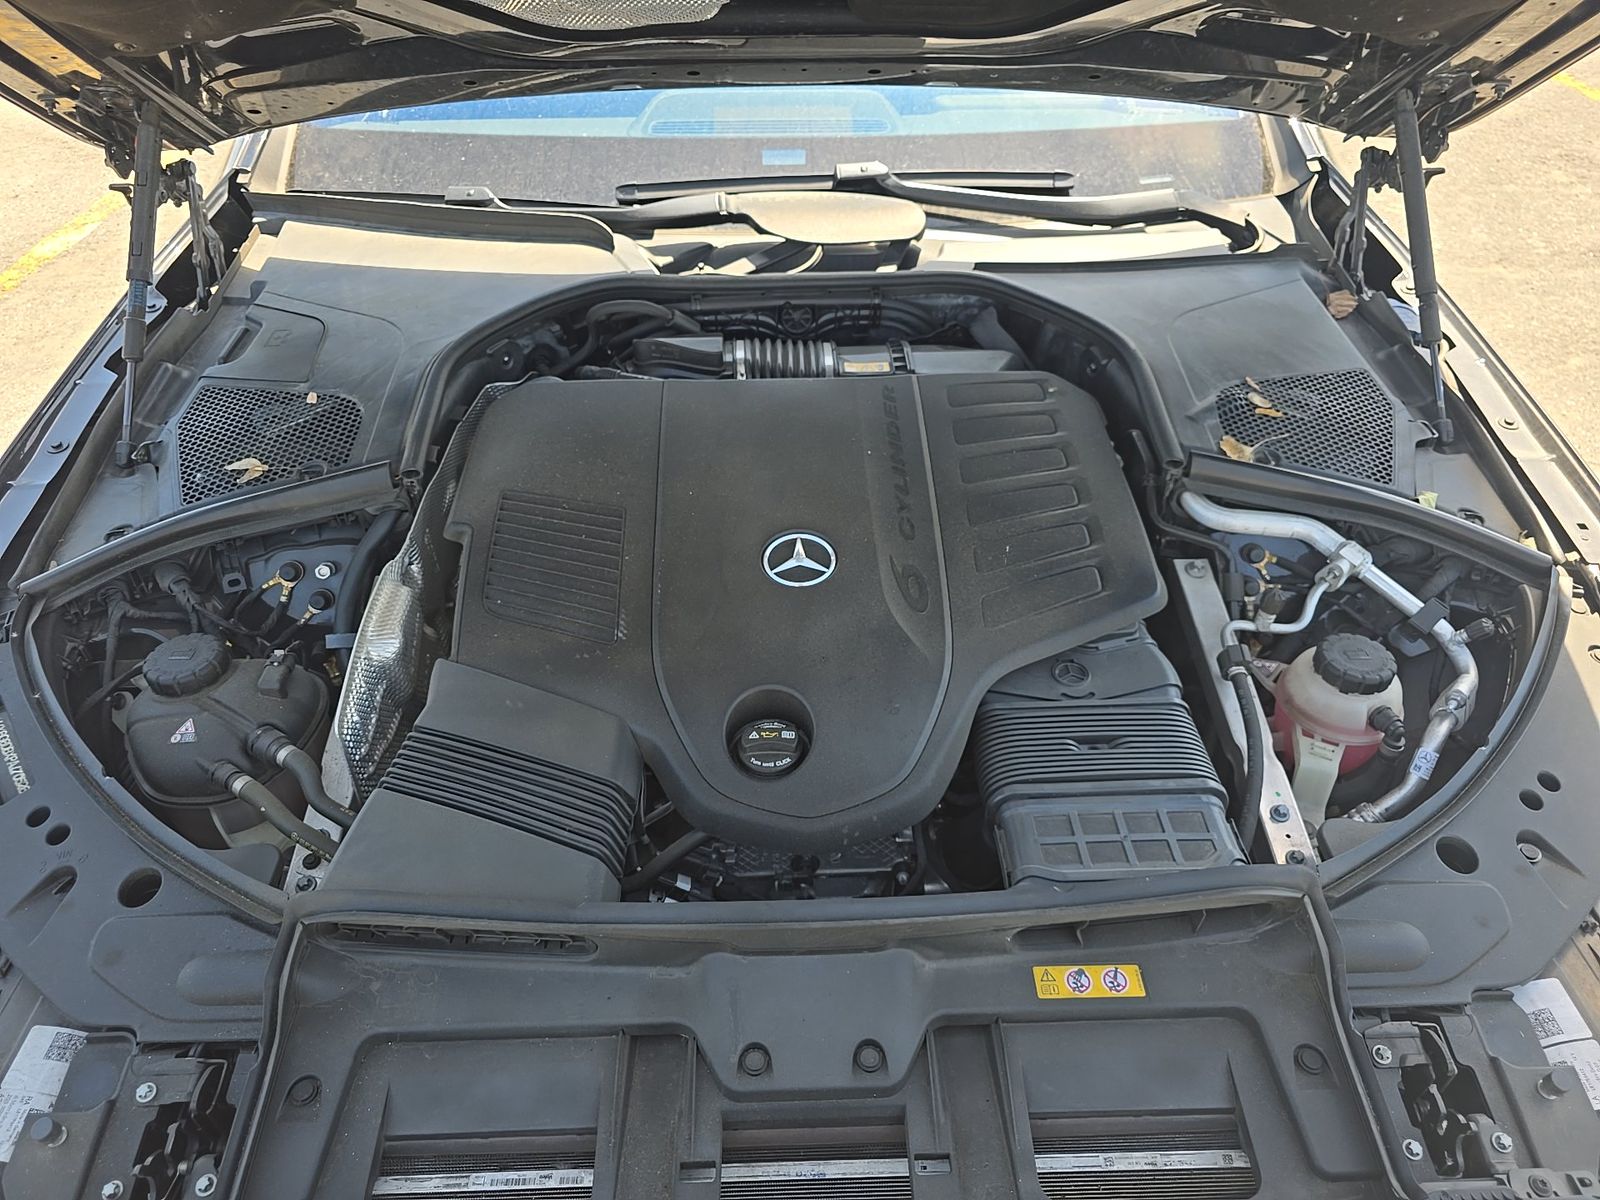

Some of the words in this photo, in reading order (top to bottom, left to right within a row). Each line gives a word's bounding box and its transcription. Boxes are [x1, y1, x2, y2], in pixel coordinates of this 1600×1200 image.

[881, 384, 915, 541] CYLINDER
[889, 554, 929, 614] 6
[776, 756, 792, 767] CLICK
